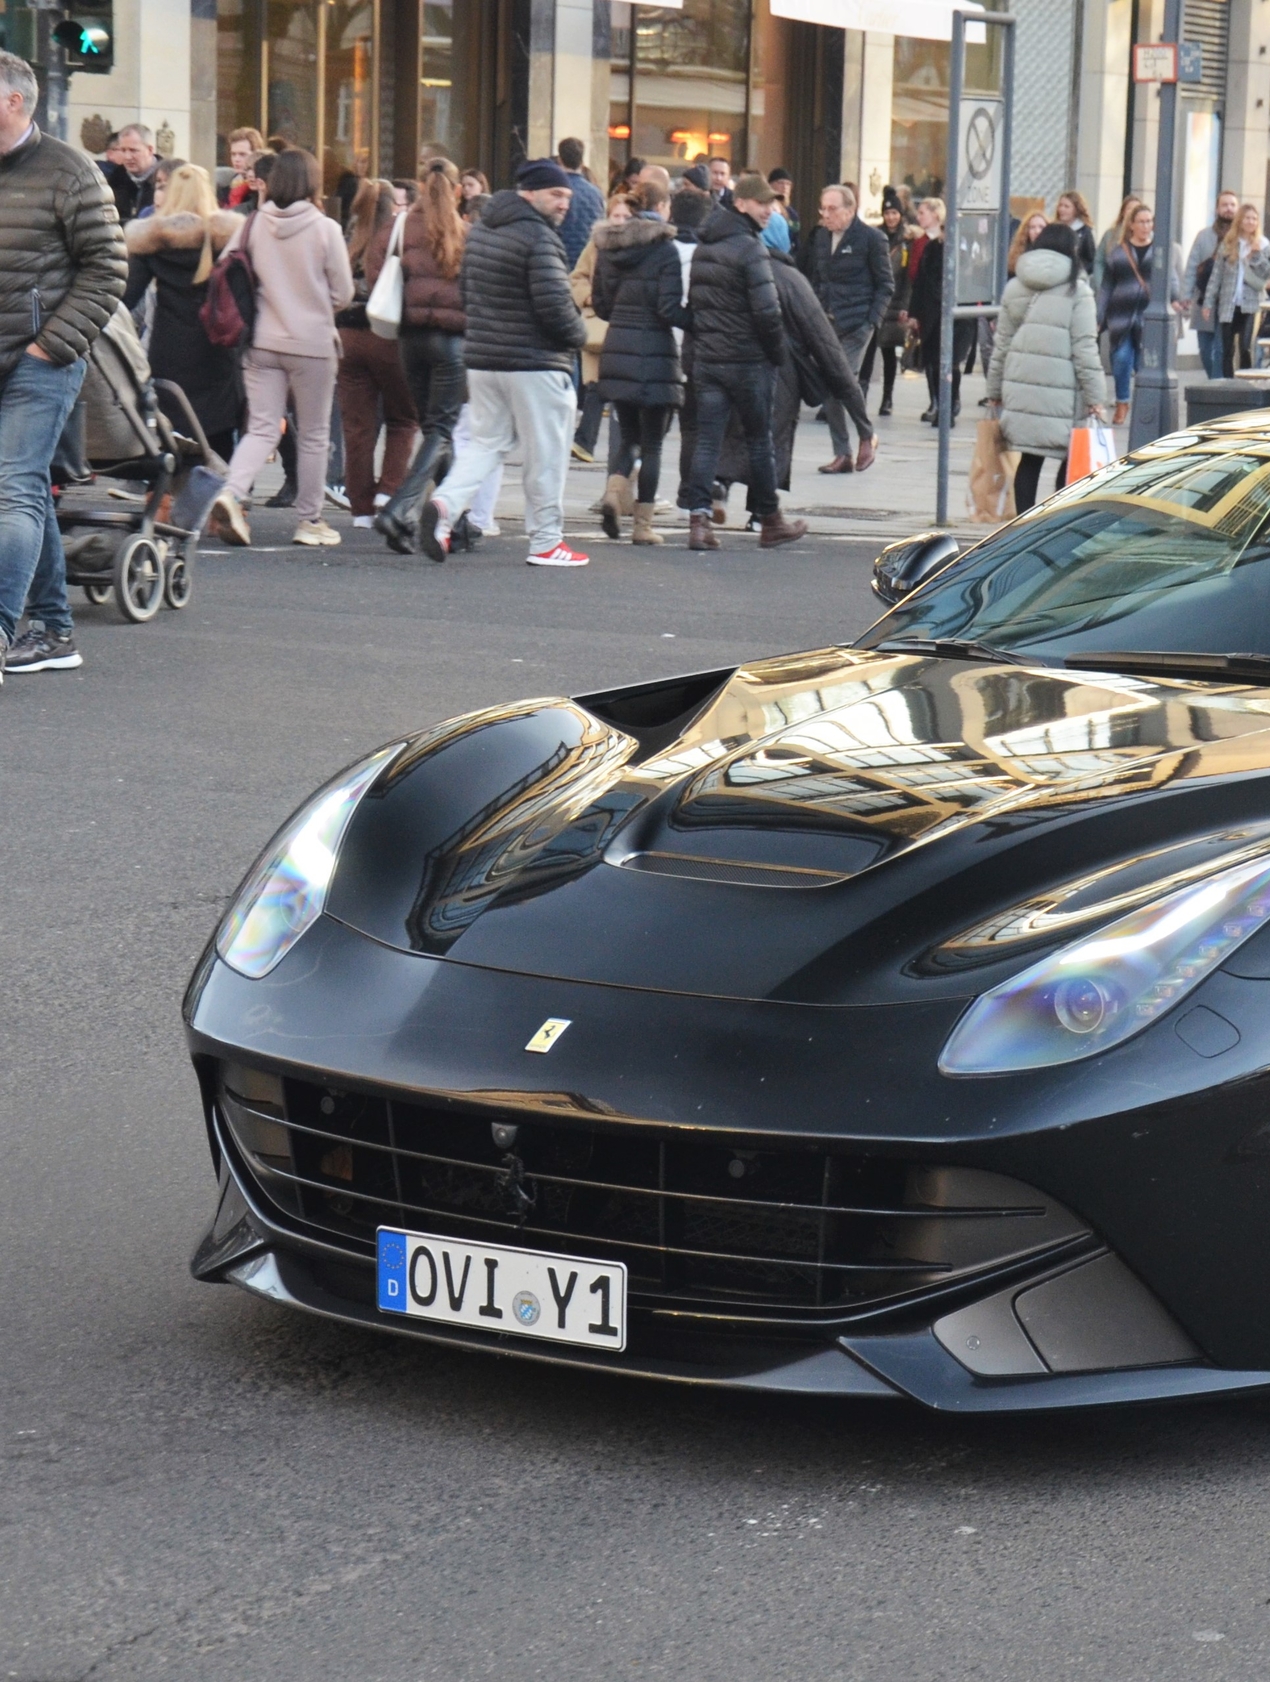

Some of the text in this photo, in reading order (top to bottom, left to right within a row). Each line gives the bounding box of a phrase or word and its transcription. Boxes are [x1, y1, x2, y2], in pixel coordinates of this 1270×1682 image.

[967, 186, 990, 203] ZONE
[388, 1279, 399, 1297] D
[409, 1244, 503, 1319] OVI
[547, 1267, 618, 1337] Y1
